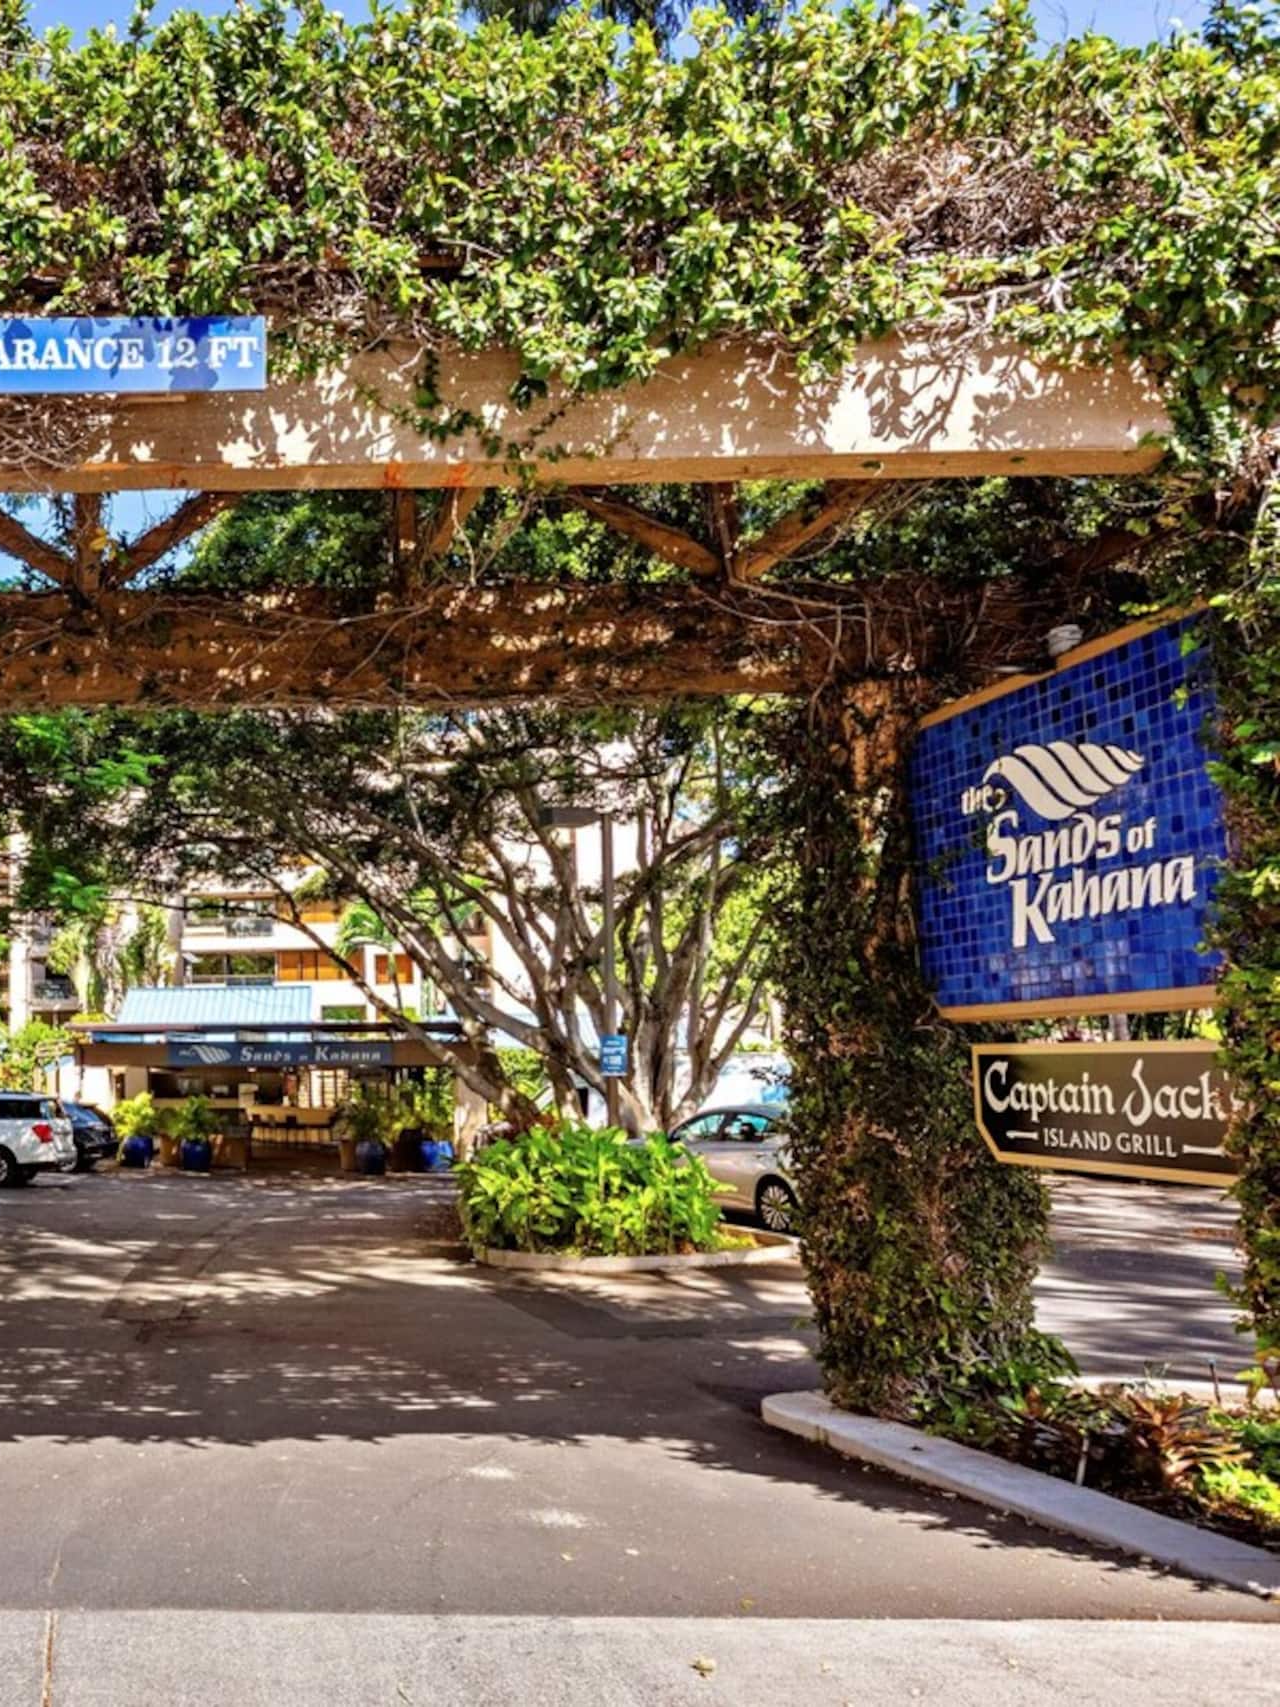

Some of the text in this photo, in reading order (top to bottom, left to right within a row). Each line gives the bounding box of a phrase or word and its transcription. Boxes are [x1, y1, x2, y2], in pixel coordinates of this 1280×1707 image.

[157, 336, 197, 369] 12
[208, 335, 259, 369] FT
[960, 785, 1007, 815] the
[986, 809, 1158, 884] Sands of
[1008, 855, 1197, 948] Kahana
[984, 1060, 1116, 1123] Captain
[1042, 1126, 1177, 1158] ISLAND GRILL
